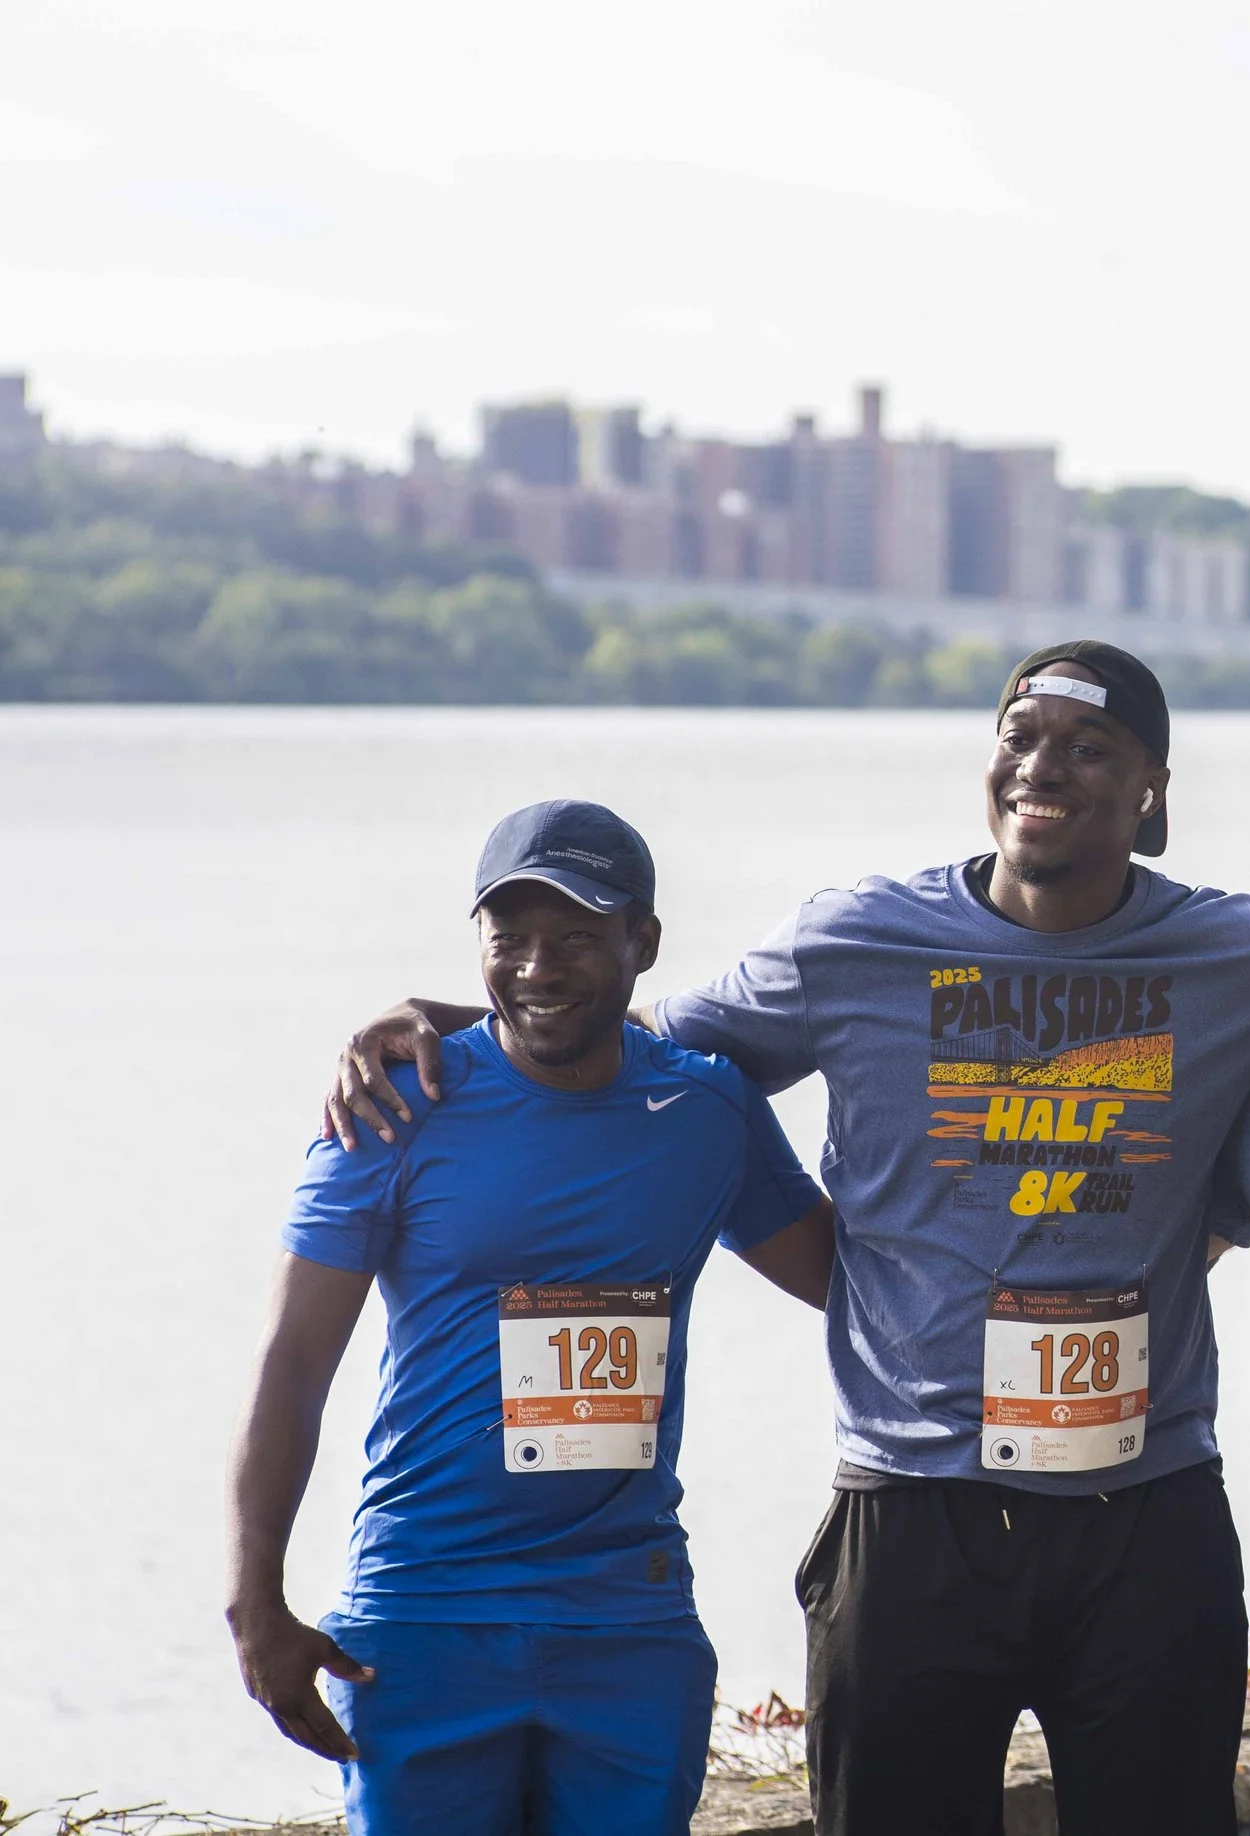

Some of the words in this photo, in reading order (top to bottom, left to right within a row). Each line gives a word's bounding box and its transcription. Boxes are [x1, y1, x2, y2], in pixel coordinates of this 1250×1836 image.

[930, 967, 981, 988] 2025
[930, 974, 1174, 1051] PALISADES
[984, 1097, 1124, 1142] HALF
[978, 1143, 1117, 1166] MARATHON
[1085, 1173, 1133, 1191] TRAIL
[1009, 1170, 1087, 1217] 8K
[1077, 1191, 1131, 1214] RUN
[537, 1289, 582, 1298] Palisades
[632, 1291, 656, 1300] CHPE
[1023, 1295, 1068, 1304] Palisades
[1117, 1291, 1138, 1303] CHPE
[506, 1302, 533, 1310] 2025
[537, 1300, 559, 1309] Half
[561, 1300, 607, 1309] Marathon
[994, 1303, 1019, 1312] 2025
[1023, 1306, 1043, 1314] Half
[1046, 1307, 1093, 1315] Marathon
[548, 1326, 638, 1390] 129
[1031, 1330, 1120, 1394] 128
[518, 1375, 533, 1388] M
[997, 1405, 1031, 1413] Palisades
[996, 1418, 1042, 1426] Conservancy
[641, 1441, 652, 1459] 129
[1118, 1435, 1135, 1454] 128
